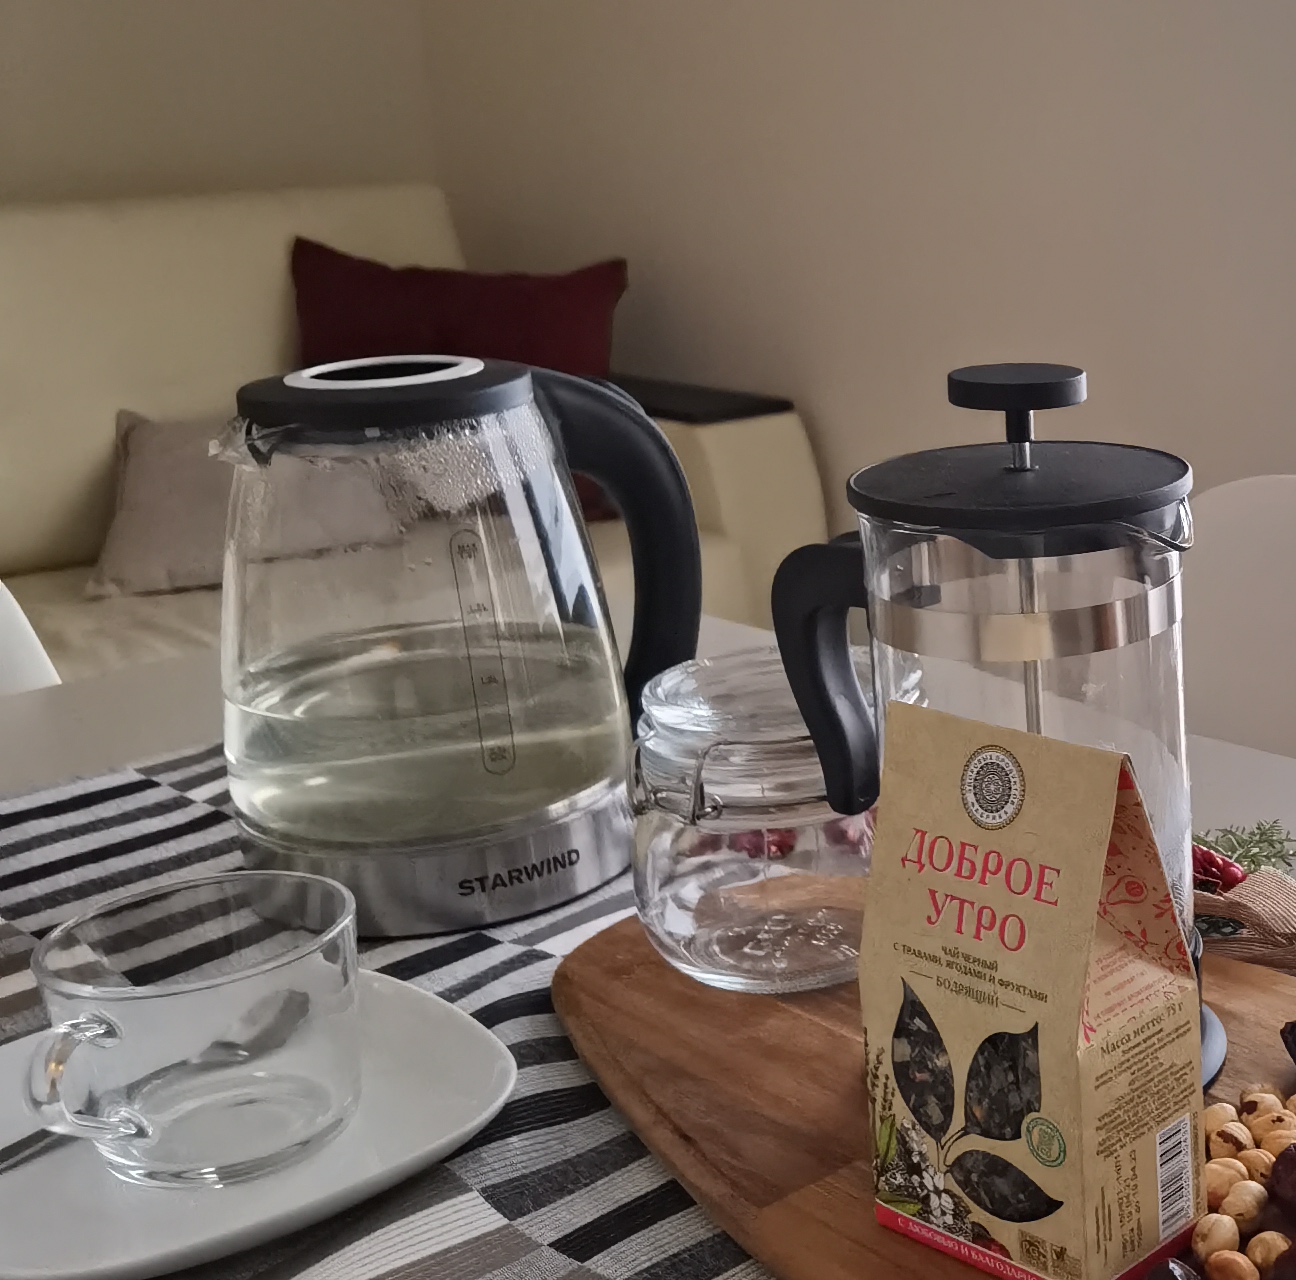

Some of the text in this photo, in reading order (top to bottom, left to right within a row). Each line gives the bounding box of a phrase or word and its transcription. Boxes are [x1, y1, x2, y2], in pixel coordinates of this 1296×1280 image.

[458, 848, 581, 897] STARWIND
[901, 827, 1061, 907] ДОБРОЕ
[926, 888, 1026, 952] УТРО
[893, 942, 1048, 1004] С ТРАВАМИ, ЯГОДАМИ И ФРУКТАМИ
[941, 945, 998, 973] ЧАЙ ЧЕРНЫЙ
[1100, 1031, 1131, 1056] Масса
[907, 1222, 959, 1252] ЛЮБОВЬЮ
[960, 1242, 969, 1257] И
